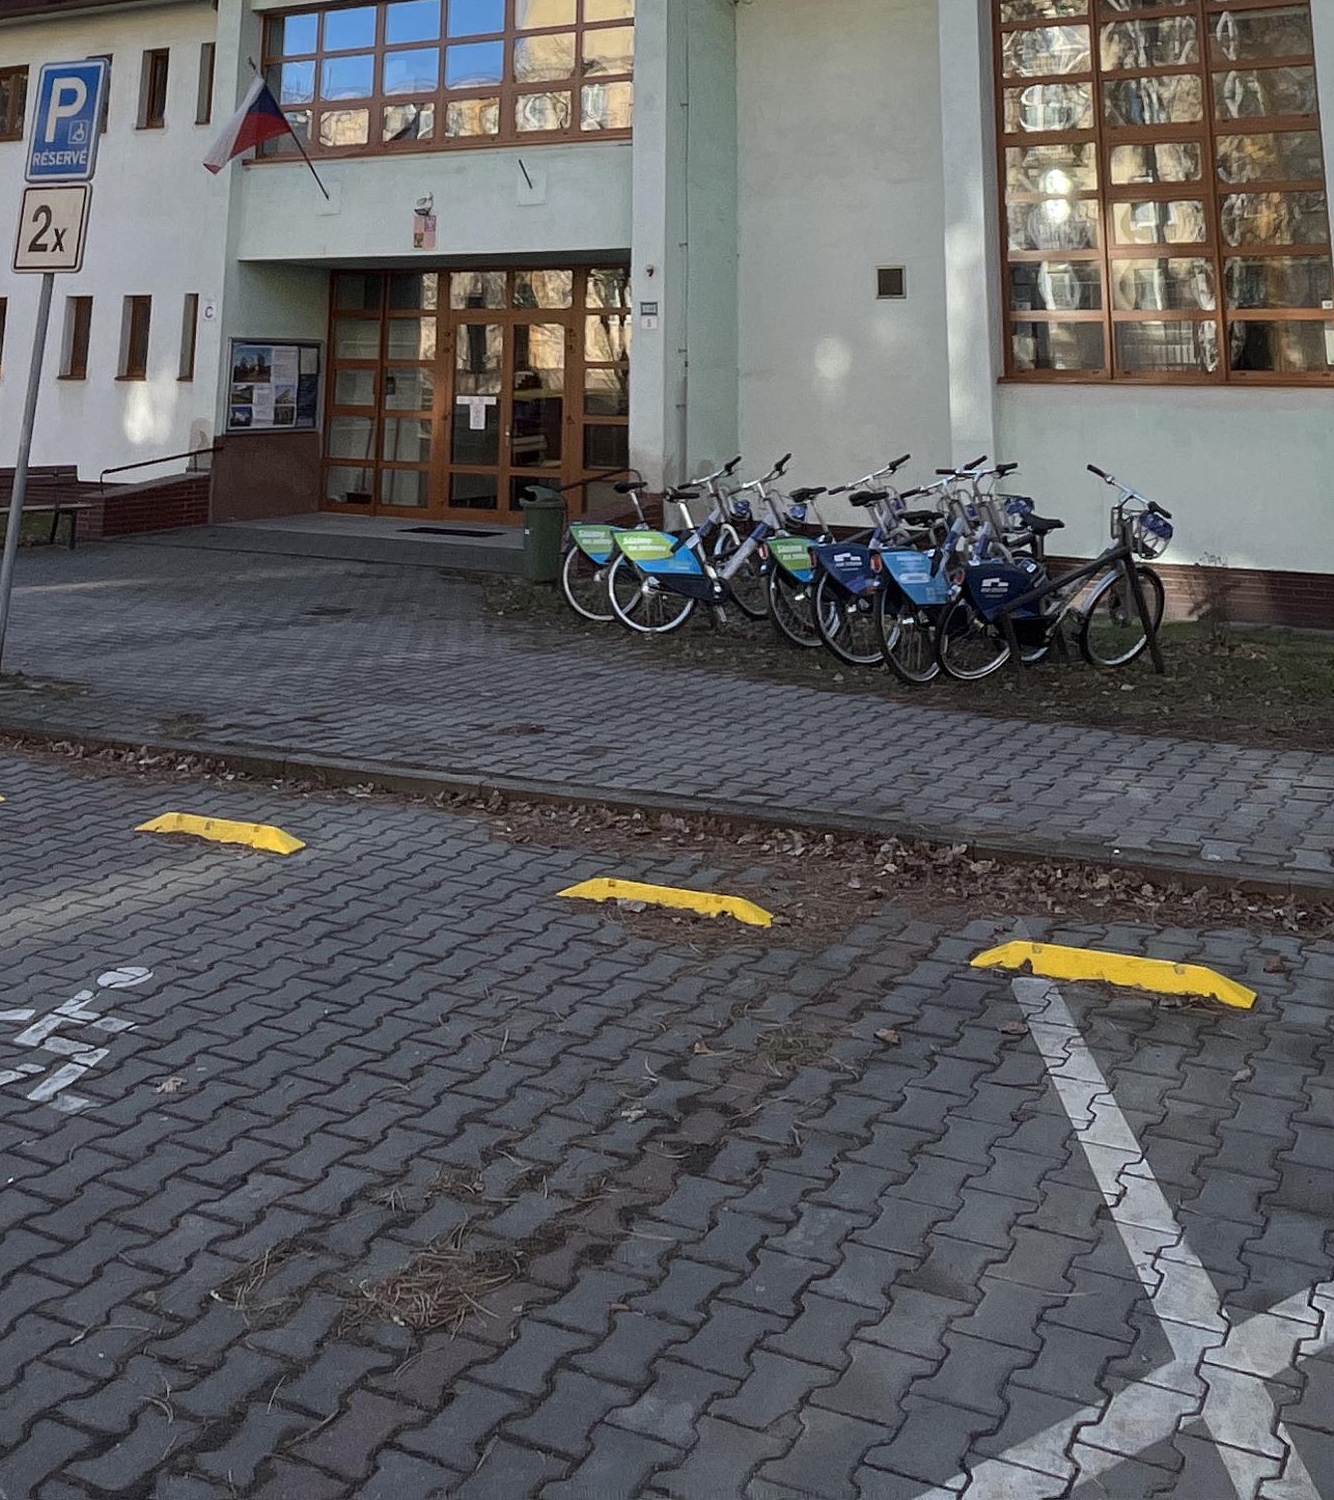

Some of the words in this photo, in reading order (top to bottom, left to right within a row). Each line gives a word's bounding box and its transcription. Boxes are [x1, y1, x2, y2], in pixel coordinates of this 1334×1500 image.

[45, 76, 88, 143] P
[33, 148, 88, 166] RÉSERVÉ
[28, 204, 69, 253] 2x
[205, 306, 213, 318] C
